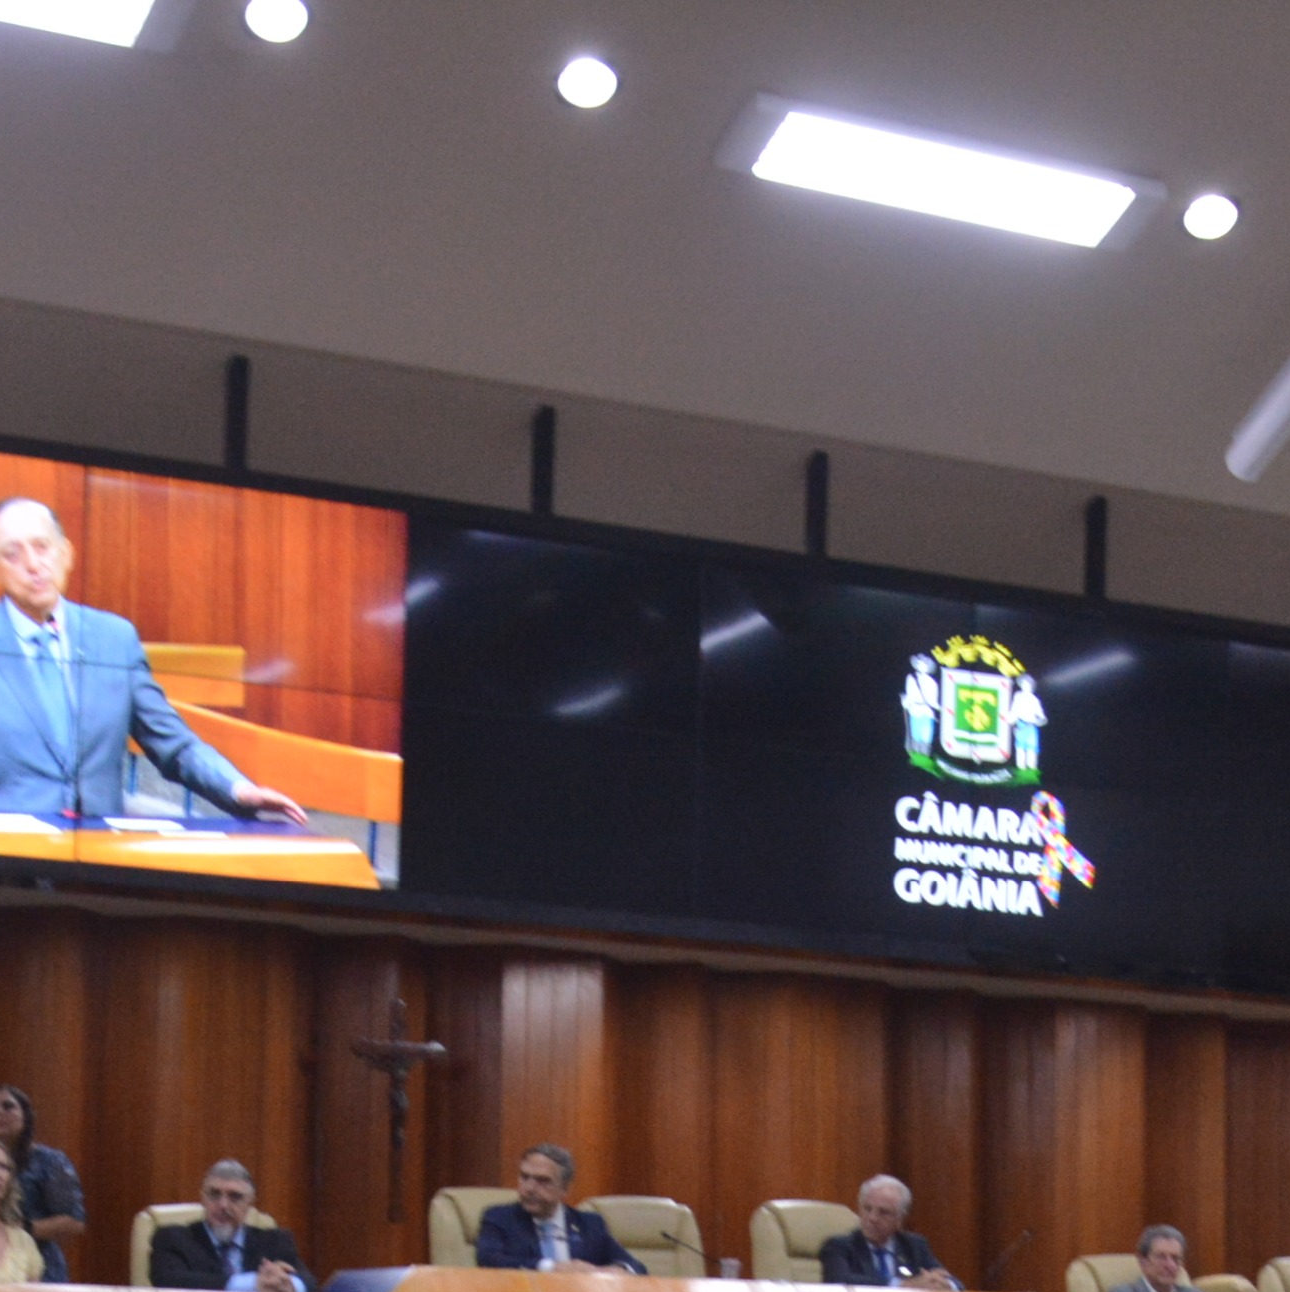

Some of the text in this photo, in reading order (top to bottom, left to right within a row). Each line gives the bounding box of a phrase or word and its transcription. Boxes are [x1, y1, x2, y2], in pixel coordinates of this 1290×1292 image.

[894, 790, 1043, 846] CÂMARA
[894, 837, 1042, 876] MUNICIPAL DE
[893, 867, 1043, 917] GOIÂNIA
